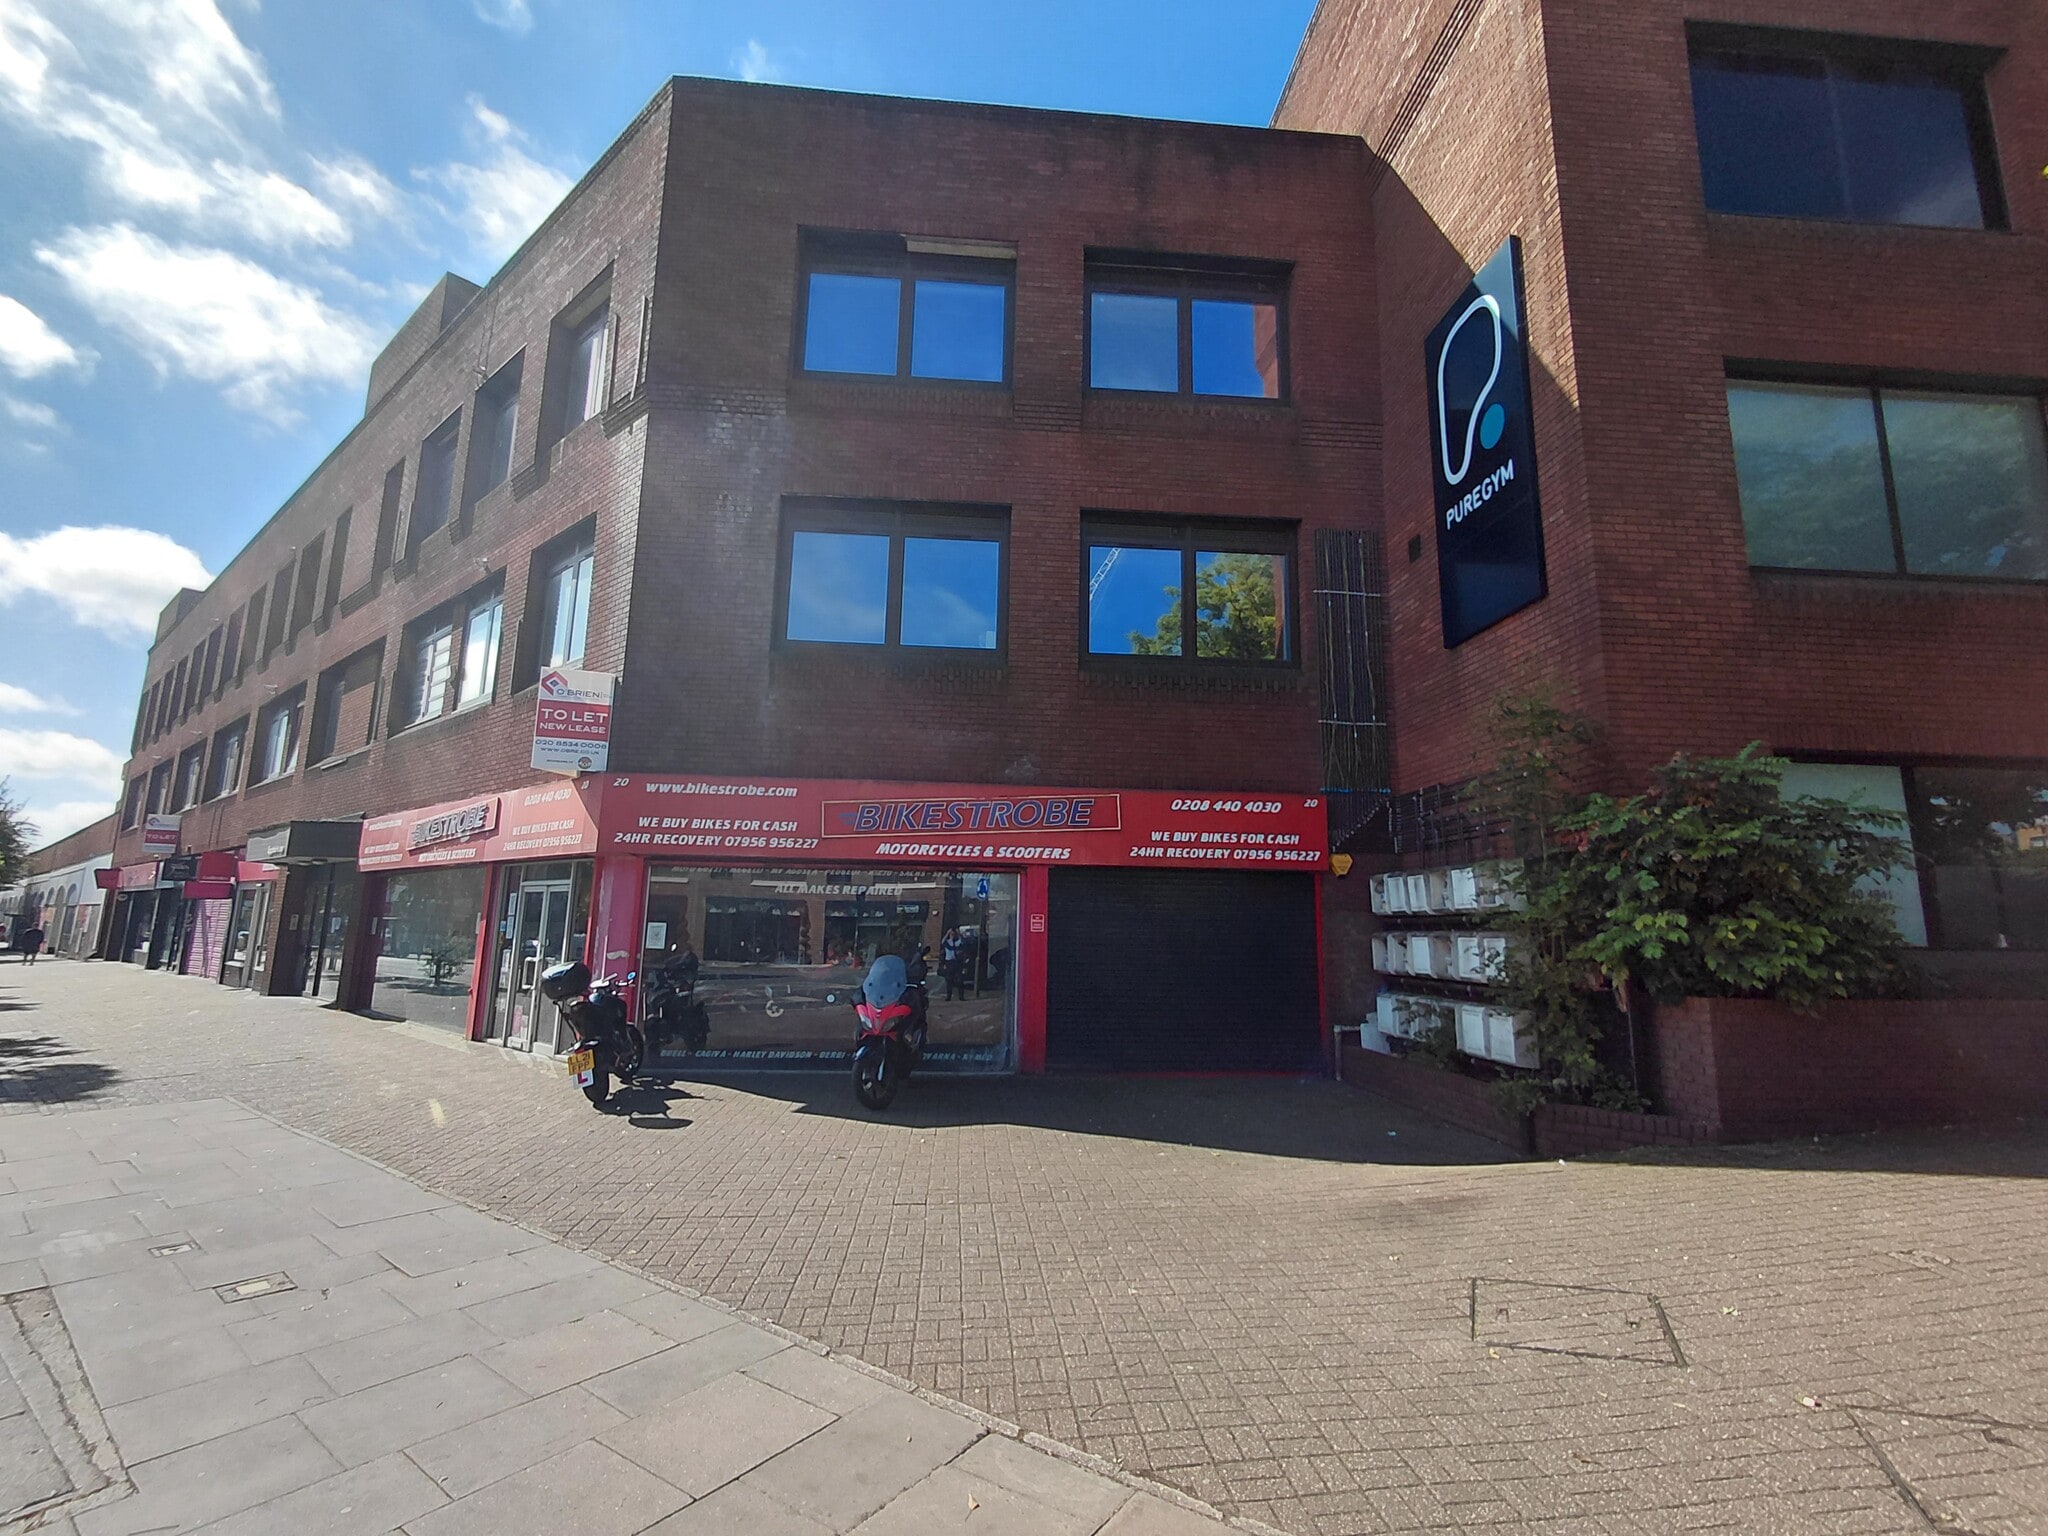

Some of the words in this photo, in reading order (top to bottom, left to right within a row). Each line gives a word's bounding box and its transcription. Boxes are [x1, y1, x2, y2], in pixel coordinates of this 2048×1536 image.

[1446, 458, 1514, 530] PUREGYM
[541, 708, 567, 720] TO
[572, 711, 608, 723] LET
[540, 722, 566, 730] NEW
[568, 724, 606, 734] LEASE
[613, 777, 630, 787] 20
[646, 782, 798, 797] www.bikestrobe.com
[554, 788, 572, 800] 4030
[1171, 799, 1211, 811] 0208
[1213, 800, 1242, 812] 440
[1244, 801, 1282, 813] 4030
[1303, 798, 1319, 808] 20
[854, 798, 1095, 832] BIKESTROBE
[415, 802, 487, 844] BIKESTROBE
[531, 822, 547, 834] BIKES
[547, 821, 559, 831] FOR
[559, 819, 575, 830] CASH
[638, 816, 660, 828] WE
[662, 817, 688, 828] BUY
[691, 818, 731, 830] BIKES
[733, 819, 760, 830] FOR
[762, 820, 798, 832] CASH
[517, 838, 542, 849] RECOVERY
[560, 833, 583, 846] 956227
[613, 832, 651, 843] 24HR
[653, 833, 722, 846] RECOVERY
[724, 836, 767, 848] 07956
[769, 837, 819, 849] 956227
[1151, 831, 1171, 841] WE
[1173, 831, 1197, 842] BUY
[1200, 832, 1238, 843] BIKES
[1240, 833, 1265, 844] FOR
[1267, 834, 1299, 845] CASH
[875, 842, 980, 857] MOTORCYCLES
[982, 846, 994, 857] &
[999, 846, 1071, 860] SCOOTERS
[1129, 846, 1164, 857] 24HR
[1166, 847, 1230, 859] RECOVERY
[1233, 849, 1272, 860] 07956
[1275, 850, 1321, 861] 956227
[775, 884, 795, 894] ALL
[796, 884, 840, 895] MAKES
[842, 885, 903, 896] REPAIRED
[732, 1050, 767, 1059] HARLEY
[768, 1050, 812, 1059] DAVIDSON
[577, 1072, 589, 1085] L
